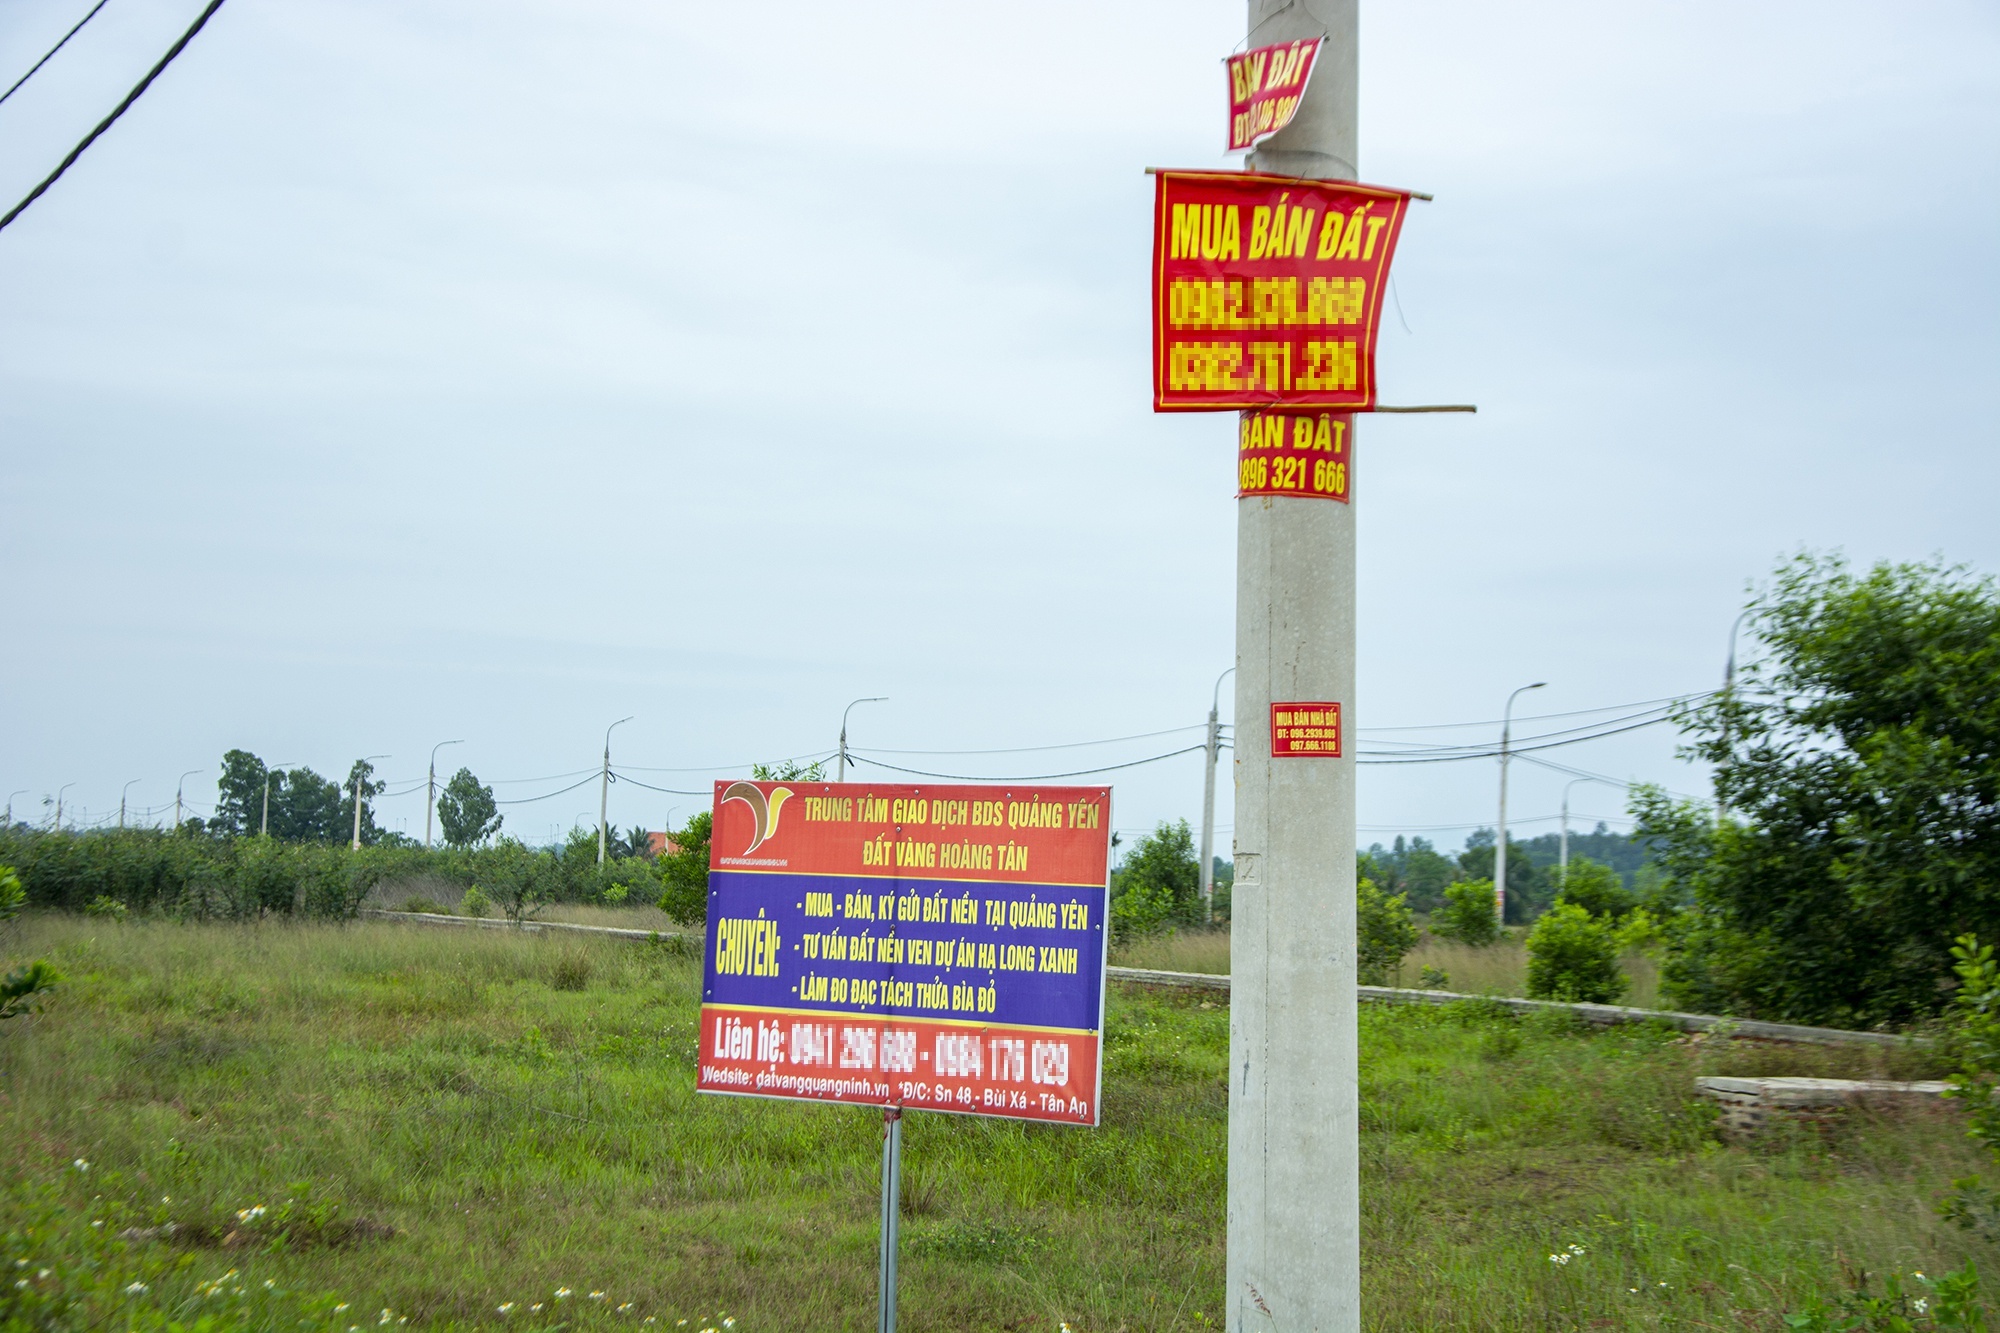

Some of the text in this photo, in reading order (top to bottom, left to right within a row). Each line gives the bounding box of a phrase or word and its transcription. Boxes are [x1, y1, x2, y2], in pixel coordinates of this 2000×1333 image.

[1170, 192, 1387, 261] MUA BÁN ĐẤT
[1240, 412, 1285, 451] BÁN
[1240, 456, 1345, 494] 896 321 666
[1276, 711, 1293, 726] MUA
[1293, 708, 1309, 726] BÁN
[805, 793, 1099, 830] TRUNG TÂM GIAO DỊCH BDS QUẢNG YÊN
[863, 832, 1028, 871] ĐẤT VÀNG HOÀNG TÂN
[805, 892, 833, 917] MUA
[844, 889, 875, 922] BÁN,
[878, 890, 895, 920] KÝ
[898, 888, 920, 922] GỬI
[923, 889, 948, 923] ĐẤT
[951, 890, 978, 924] NỀN
[985, 900, 1006, 931] TẠI
[1009, 893, 1056, 929] QUẢNG
[1060, 899, 1088, 930] YÊN
[716, 908, 781, 977] CHUYÊN:
[803, 932, 820, 959] TƯ
[822, 927, 847, 960] VẤN
[850, 928, 875, 962] ĐẤT
[877, 931, 904, 964] NỀN
[907, 939, 933, 965] VEN
[935, 939, 956, 972] DỰ
[956, 937, 975, 968] ÁN
[978, 943, 996, 975] HẠ
[999, 944, 1035, 972] LONG
[1038, 946, 1078, 974] XANH
[800, 971, 828, 1002] LÀM
[830, 977, 848, 1003] ĐO
[851, 978, 877, 1010] ĐẠC
[880, 976, 913, 1007] TÁCH
[916, 975, 949, 1010] THỬA
[952, 980, 974, 1012] BÌA
[976, 979, 996, 1013] ĐỎ
[714, 1017, 753, 1060] Liên
[757, 1019, 785, 1072] hệ:
[701, 1065, 753, 1085] Wedsite:
[757, 1069, 890, 1098] datvangquangninh.vn
[934, 1085, 952, 1102] Sn
[956, 1086, 972, 1103] 48
[984, 1088, 1005, 1108] Bùi
[1009, 1090, 1027, 1109] Xá
[1040, 1093, 1064, 1113] Tân
